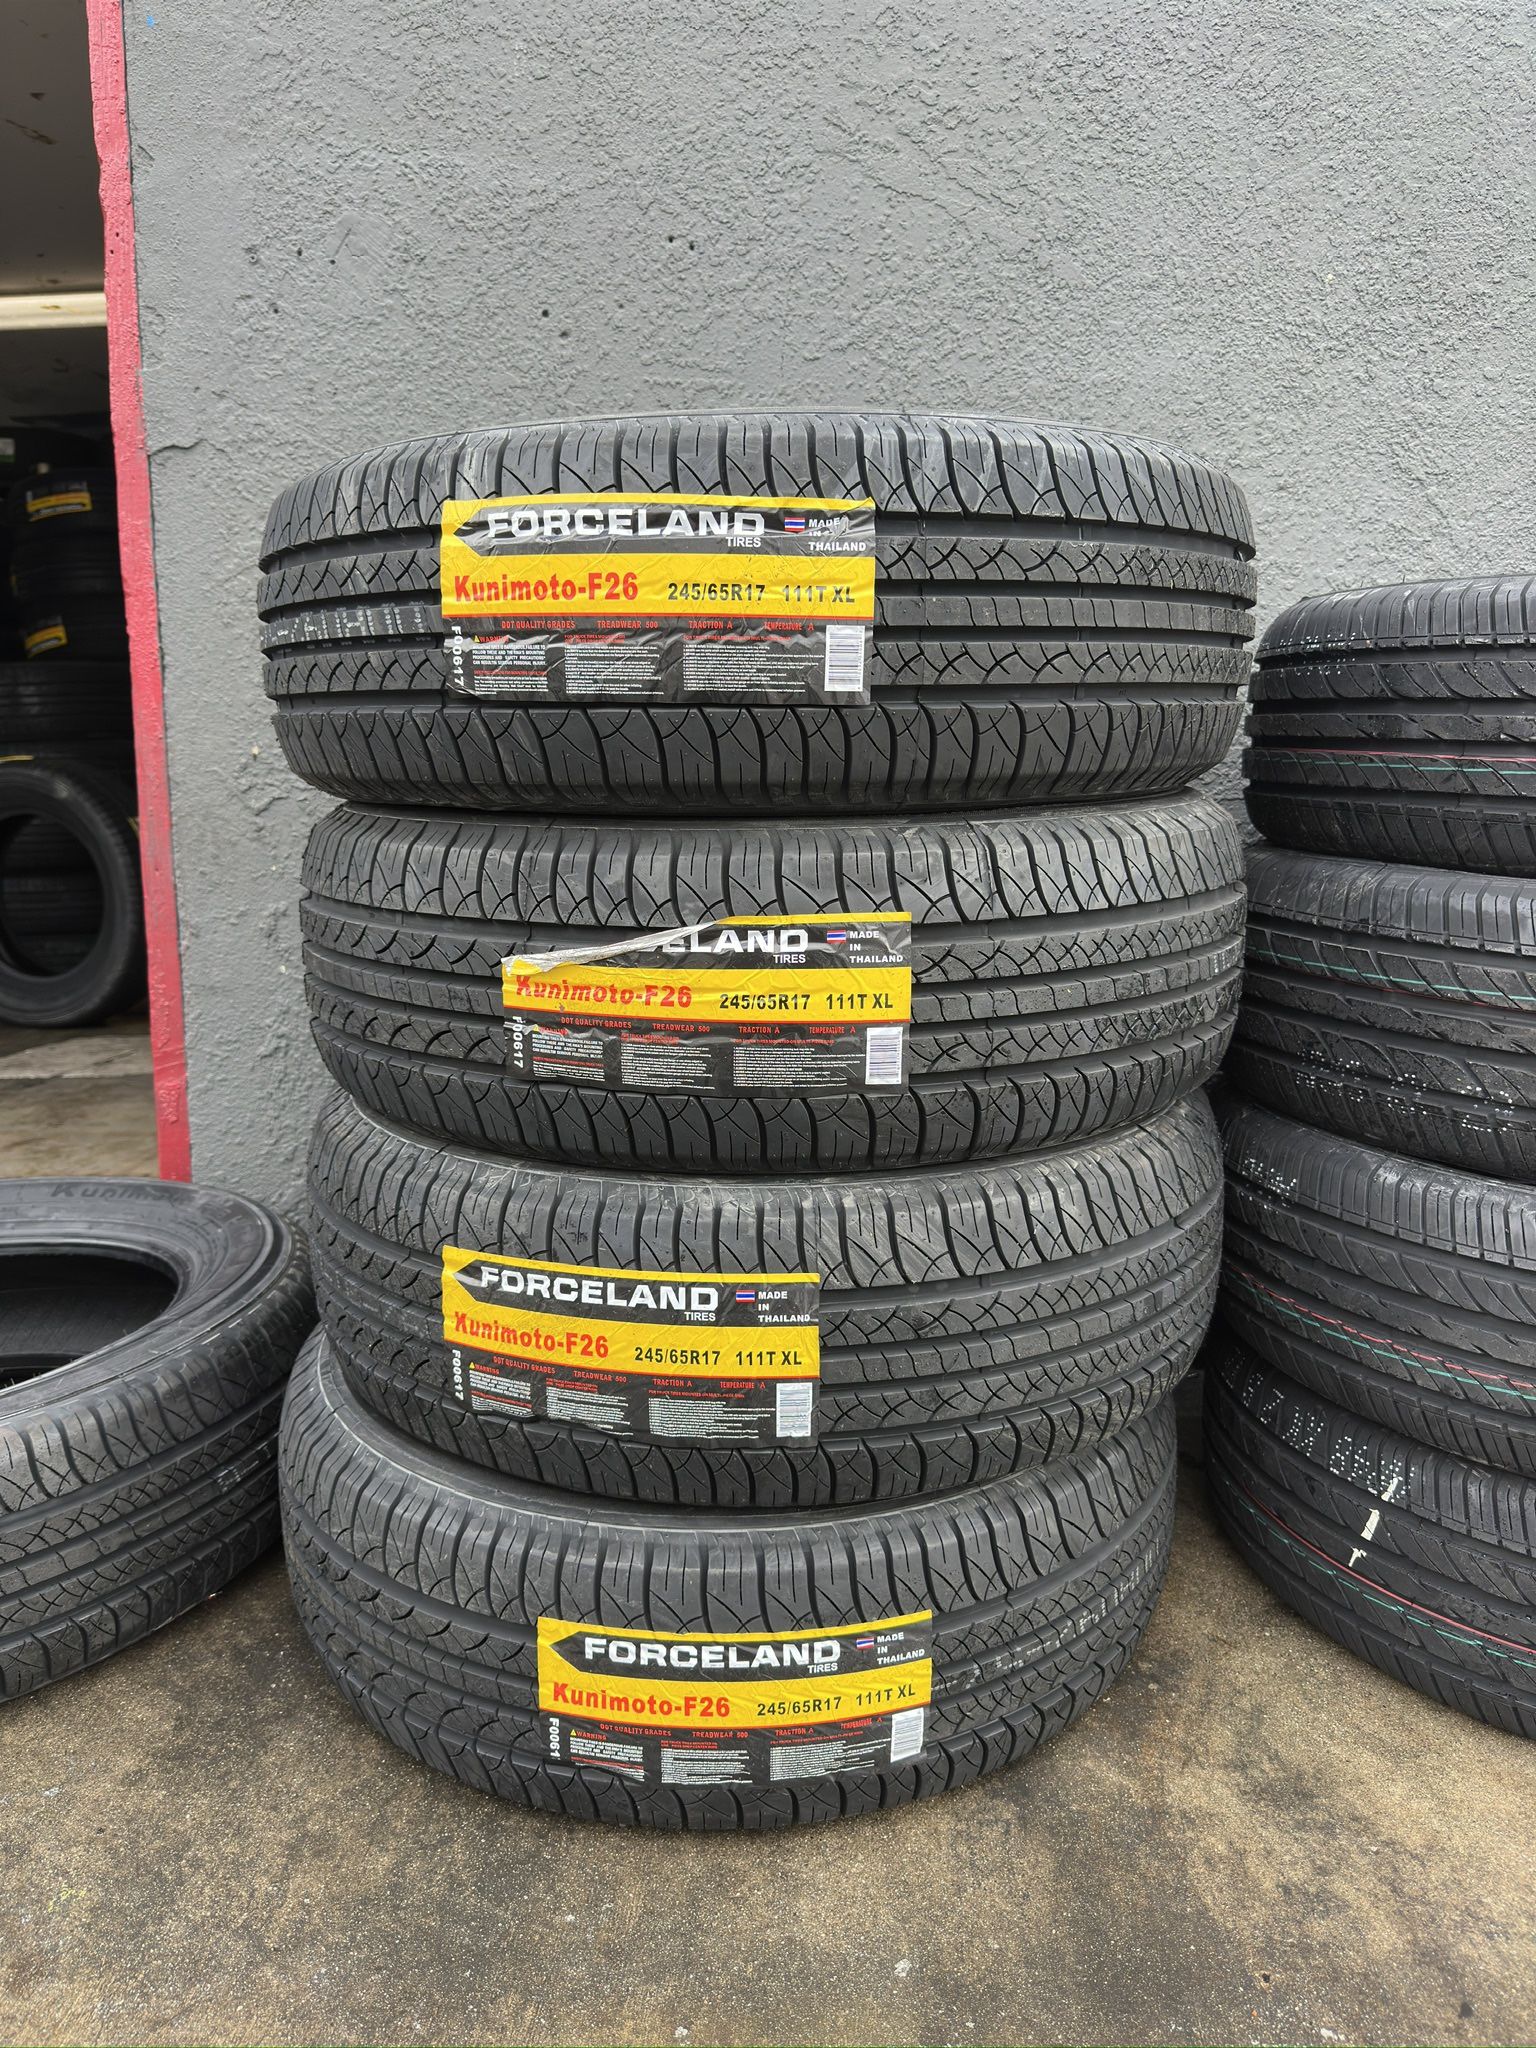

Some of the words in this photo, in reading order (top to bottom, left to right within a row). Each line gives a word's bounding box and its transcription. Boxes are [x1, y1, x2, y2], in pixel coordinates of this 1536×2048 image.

[487, 508, 765, 537] FORCELAND
[808, 517, 840, 528] MADE
[725, 537, 761, 548] TIRES
[808, 541, 866, 551] THAILAND
[454, 572, 638, 601] Kunimoto-F26
[668, 582, 765, 601] 245/65R17
[783, 584, 827, 602] 111T
[832, 586, 855, 603] XL
[516, 620, 546, 629] QUALITY
[547, 620, 576, 630] GRADES
[597, 620, 642, 629] TREADWEAR
[646, 621, 658, 629] 500
[688, 620, 723, 629] TRACTION
[726, 621, 733, 629] A
[451, 625, 465, 686] F00617
[849, 930, 880, 939] MADE
[849, 943, 861, 951] IN
[773, 954, 806, 964] TIRES
[849, 955, 904, 964] THAILAND
[515, 975, 692, 1008] Kunimoto-F26
[719, 993, 811, 1010] 245/65R17
[826, 993, 867, 1010] 111T
[872, 993, 893, 1009] XL
[574, 1018, 604, 1027] QUALITY
[604, 1020, 632, 1029] GRADES
[652, 1023, 694, 1032] TREADWEAR
[738, 1026, 772, 1034] TRACTION
[774, 1026, 781, 1034] A
[809, 1026, 845, 1034] TEMPERATURE
[850, 1026, 856, 1034] A
[480, 1266, 719, 1311] FORCELAND
[758, 1290, 788, 1299] MADE
[758, 1303, 770, 1311] IN
[684, 1311, 716, 1321] TIRES
[757, 1313, 811, 1323] THAILAND
[454, 1311, 609, 1358] Kunimoto-F26
[634, 1347, 721, 1365] 245/65R17
[736, 1351, 776, 1365] 111T
[781, 1351, 802, 1365] XL
[452, 1349, 464, 1400] F00617
[573, 1370, 612, 1382] TREADWEAR
[653, 1379, 685, 1387] TRACTION
[719, 1381, 755, 1389] TEMPERATURE
[760, 1381, 766, 1389] A
[876, 1632, 904, 1643] MADE
[584, 1637, 841, 1668] FORCELAND
[877, 1646, 888, 1654] IN
[876, 1648, 925, 1665] THAILAND
[807, 1662, 838, 1674] TIRES
[553, 1681, 730, 1717] Kunimoto-F26
[757, 1696, 842, 1716] 245/65R17
[856, 1688, 893, 1706] 111T
[897, 1683, 916, 1699] XL
[576, 1731, 607, 1741] WARNING
[614, 1725, 643, 1736] QUALITY
[644, 1728, 672, 1737] GRADES
[775, 1727, 806, 1736] TRACTION
[549, 1717, 561, 1759] F0061
